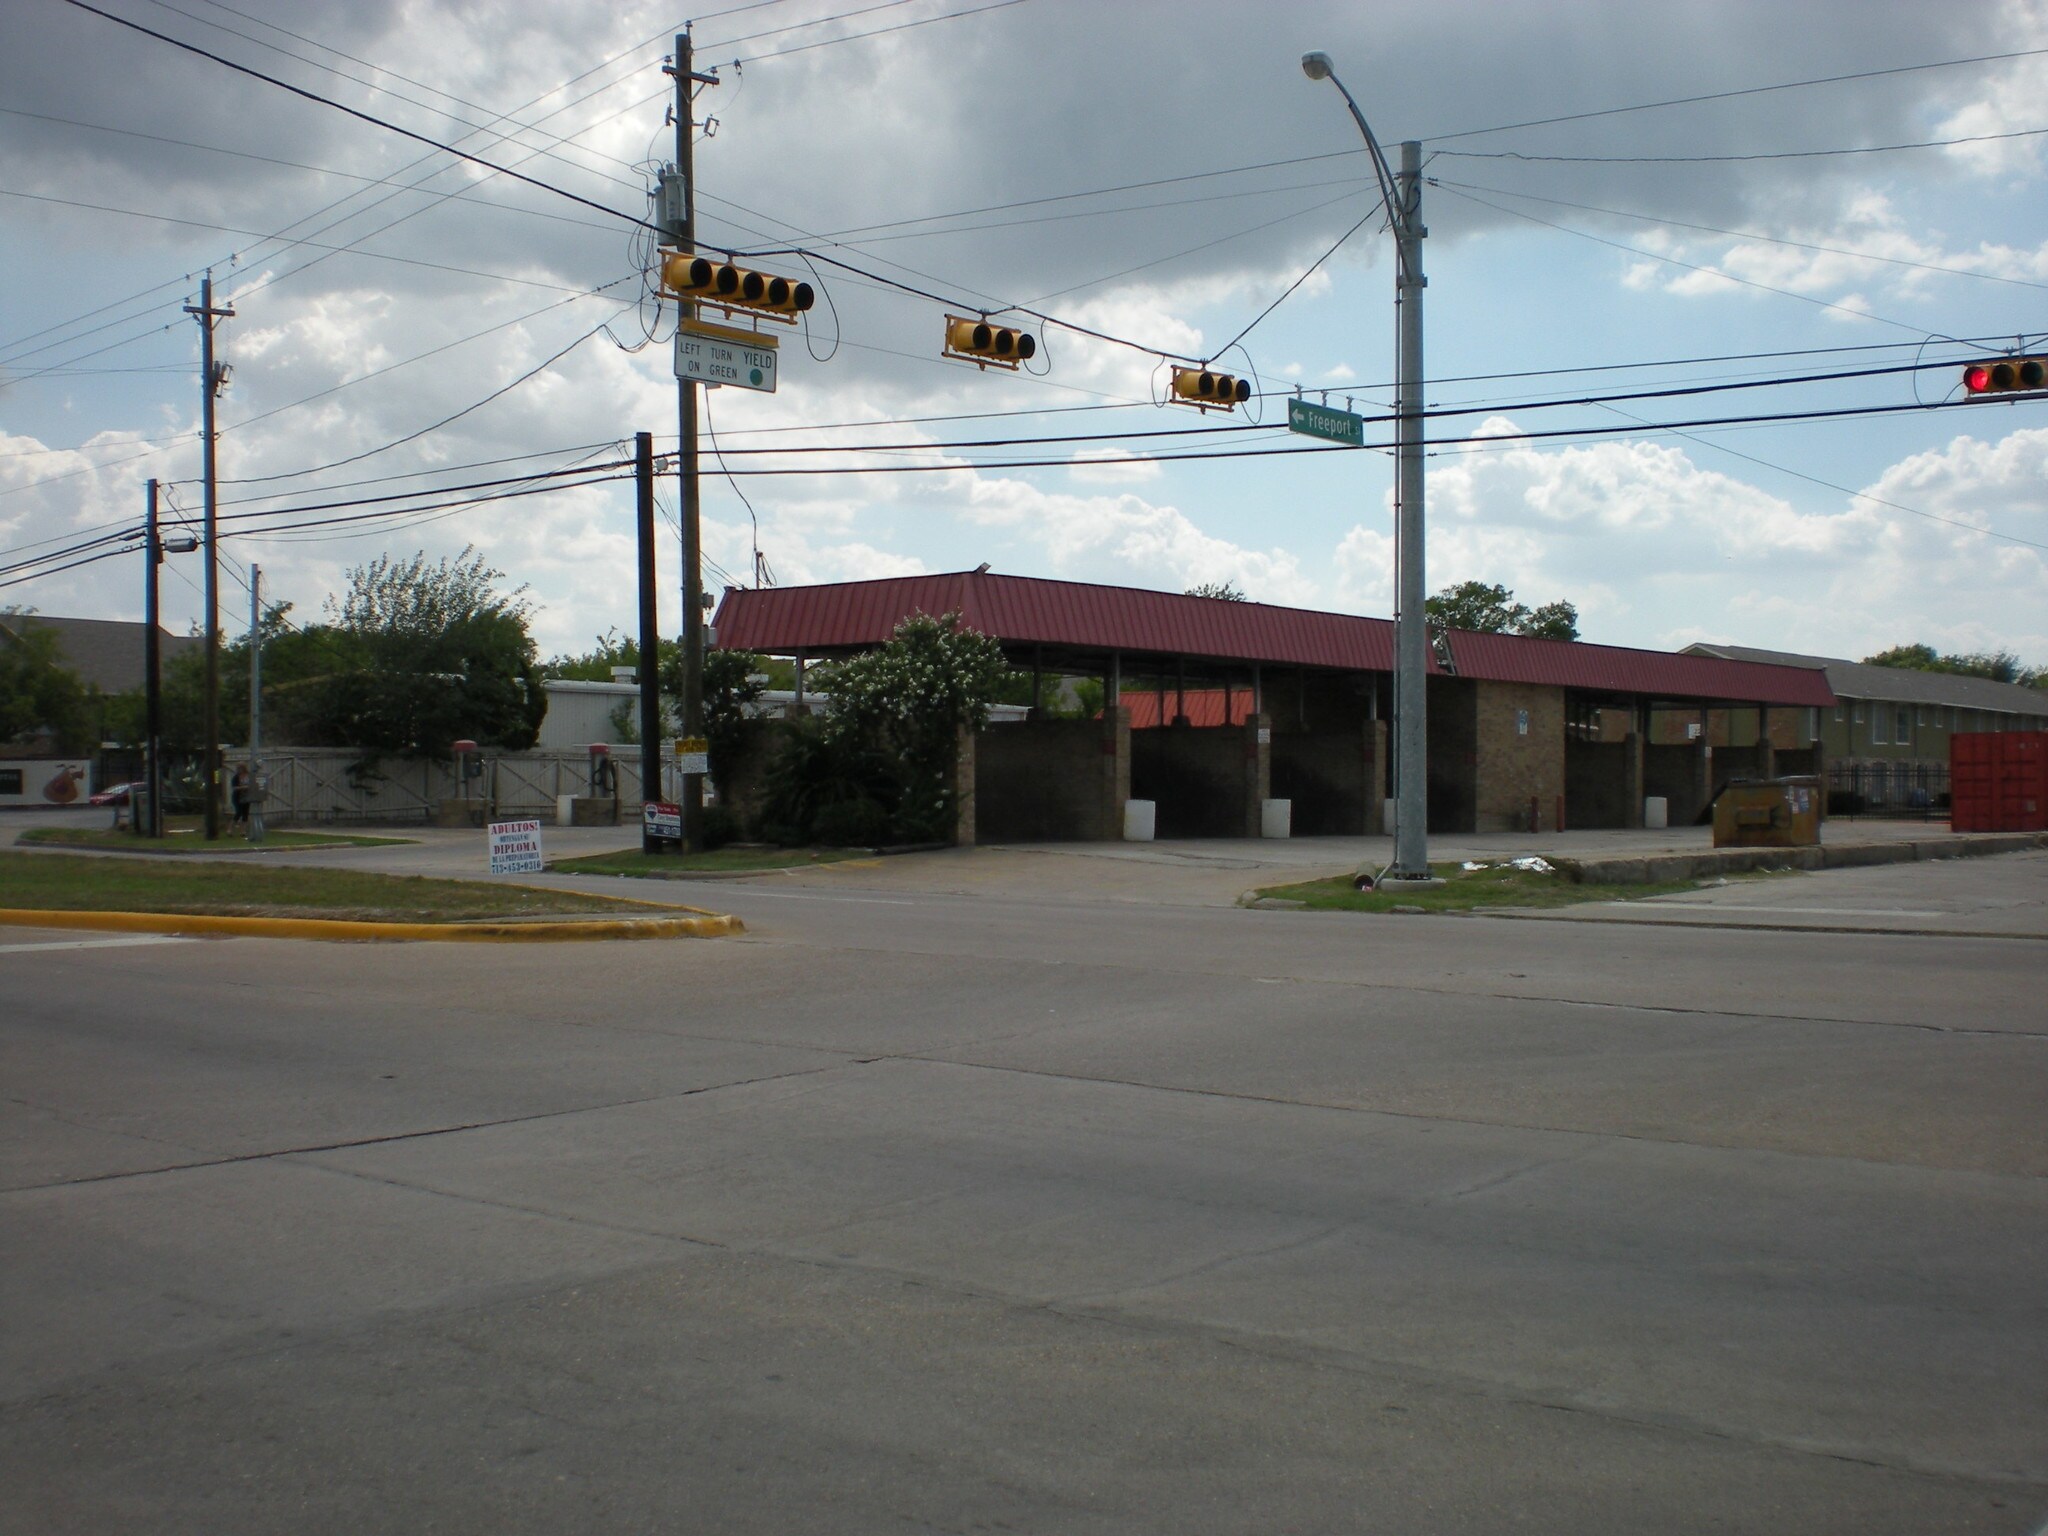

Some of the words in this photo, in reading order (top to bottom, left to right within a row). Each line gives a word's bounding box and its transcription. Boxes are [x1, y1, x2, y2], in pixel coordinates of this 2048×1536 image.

[680, 342, 700, 355] LEFT
[711, 347, 732, 361] TURN
[743, 351, 772, 369] YIELD
[688, 360, 700, 372] ON
[709, 364, 738, 379] GREEN
[1309, 411, 1351, 436] Freeport
[491, 822, 538, 835] ADULTOS!
[494, 841, 537, 854] DIPLOMA
